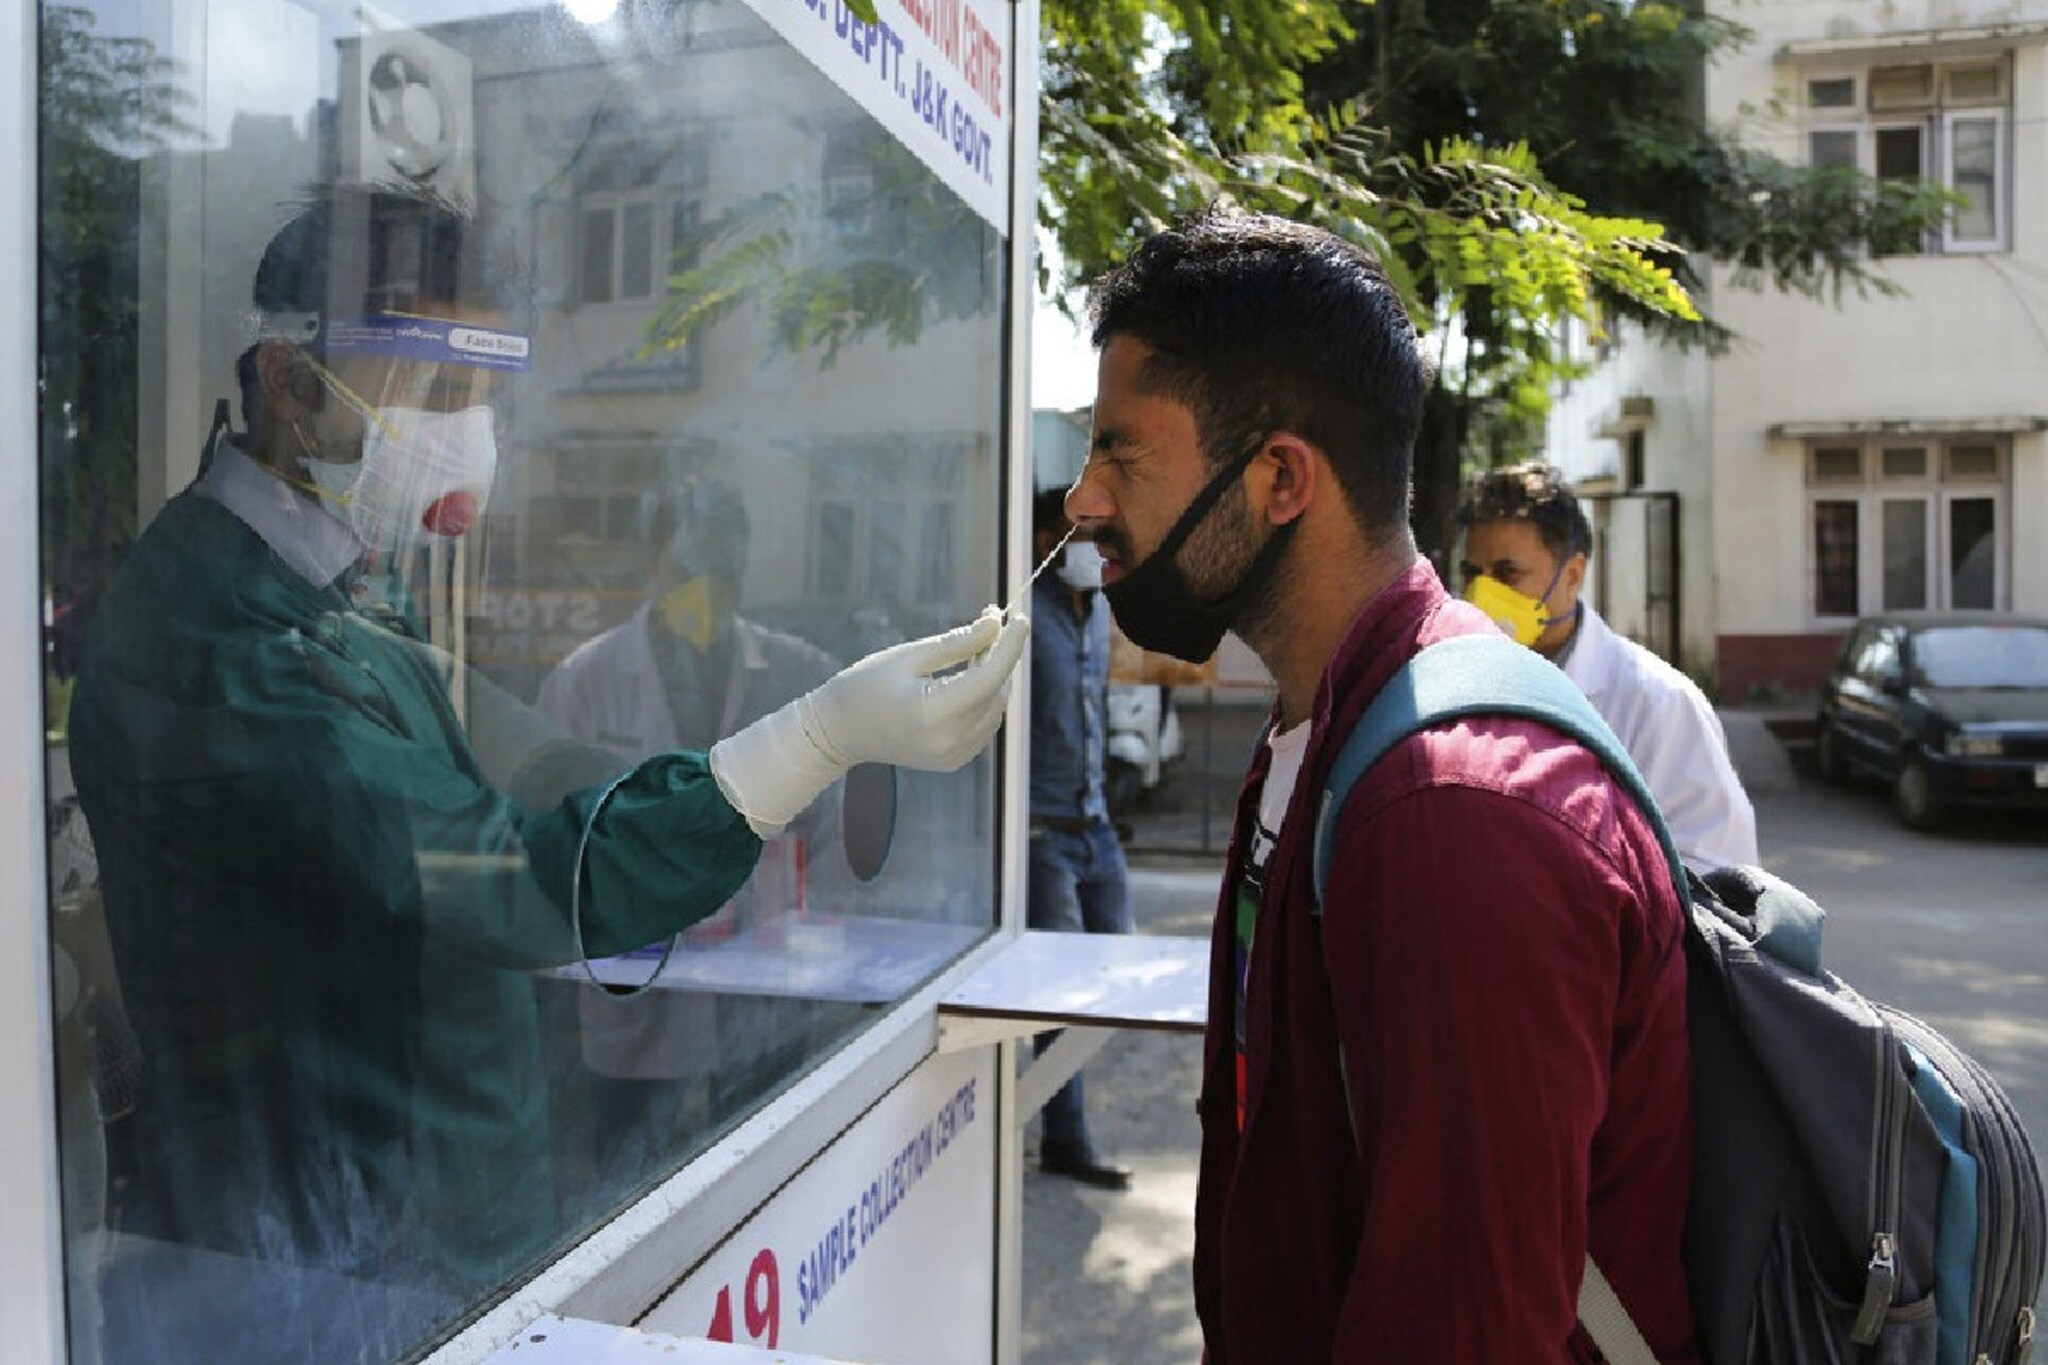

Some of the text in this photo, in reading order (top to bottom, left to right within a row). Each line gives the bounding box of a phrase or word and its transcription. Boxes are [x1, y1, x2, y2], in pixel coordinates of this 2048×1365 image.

[911, 60, 948, 140] J&K
[952, 100, 993, 185] GOVT.
[797, 1204, 856, 1325] SAMPLE
[860, 1119, 933, 1248] COLLECTION
